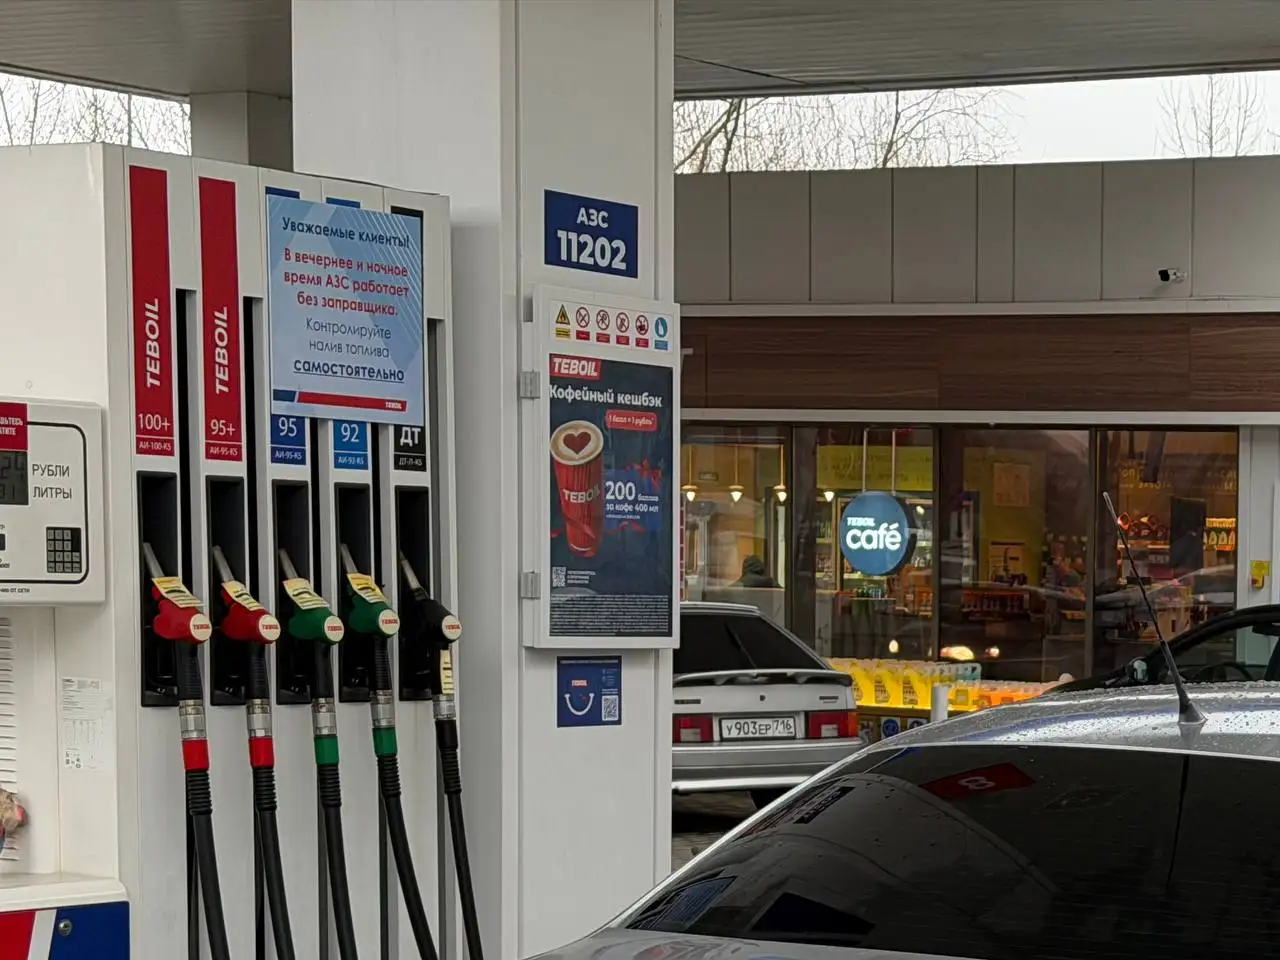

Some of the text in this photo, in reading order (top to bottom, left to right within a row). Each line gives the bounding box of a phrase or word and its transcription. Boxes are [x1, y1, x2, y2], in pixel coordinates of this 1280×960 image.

[576, 207, 609, 228] АЗС
[282, 217, 410, 248] Уважаемые клиенты!
[557, 229, 627, 270] 11202
[284, 248, 408, 277] В вечернее и ночное
[284, 271, 409, 297] время АЗС работает
[297, 291, 398, 316] без заправщика.
[306, 317, 392, 340] Контролируйте
[144, 298, 161, 388] TEBOIL
[214, 306, 229, 395] TEBOIL
[309, 340, 389, 358] налив топлива
[294, 359, 405, 382] самостоятельно
[553, 358, 598, 377] TEBOIL
[549, 384, 662, 408] Кофейный кешбэк
[138, 413, 170, 432] 100+
[210, 419, 236, 436] 95+
[278, 417, 297, 437] 95
[341, 423, 360, 443] 92
[400, 427, 421, 447] ДТ
[32, 463, 70, 477] РУБЛИ
[32, 486, 72, 500] ЛИТРЫ
[605, 481, 636, 501] 200
[615, 503, 634, 513] кофе
[635, 504, 647, 512] 400
[846, 522, 902, 551] café
[774, 719, 792, 731] 716
